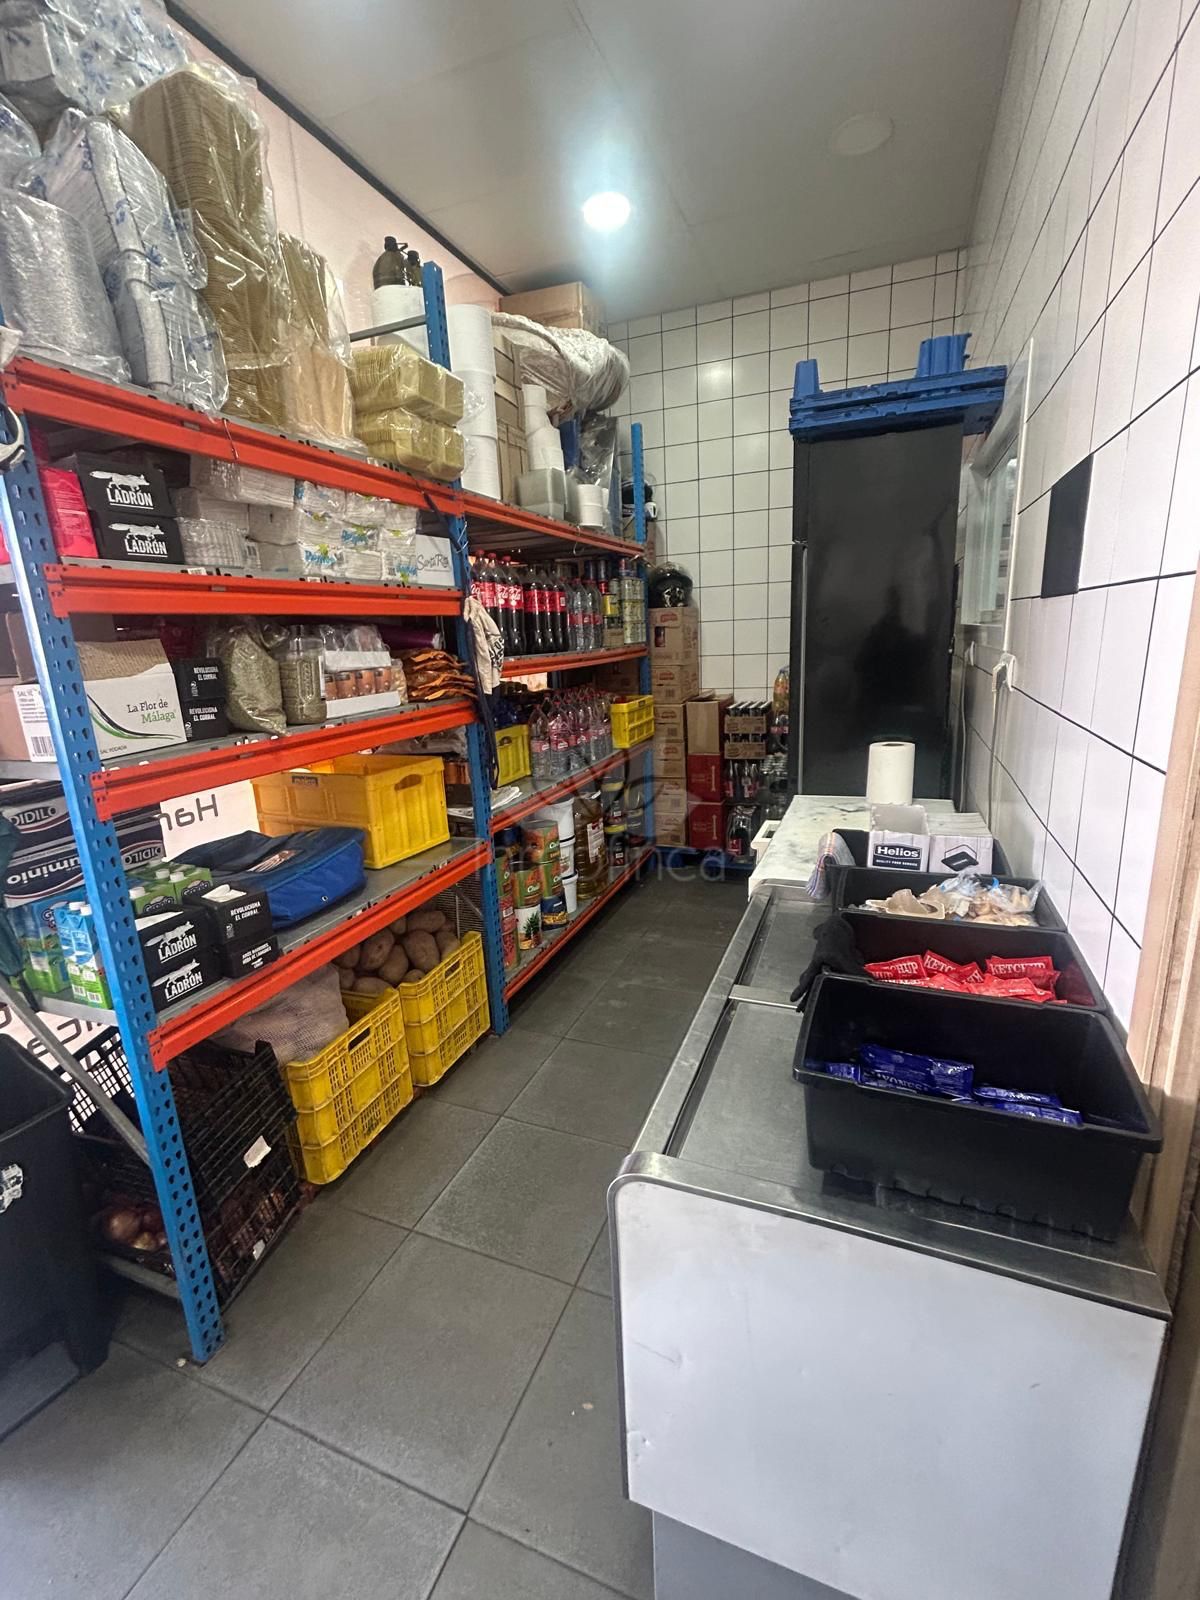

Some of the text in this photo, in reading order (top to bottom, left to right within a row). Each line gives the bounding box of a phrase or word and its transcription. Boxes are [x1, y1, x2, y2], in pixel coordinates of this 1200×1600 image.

[106, 486, 153, 506] LADRÓN
[124, 538, 168, 555] LADRÓN
[127, 698, 169, 713] La Flor de
[141, 710, 176, 724] Málaga
[9, 806, 58, 826] DIDILO
[877, 846, 919, 858] Helios
[230, 901, 261, 916] REVOLUCIONA
[158, 933, 197, 961] LADRÓN
[990, 962, 1046, 975] KETCP
[164, 971, 203, 1000] LADRÓN
